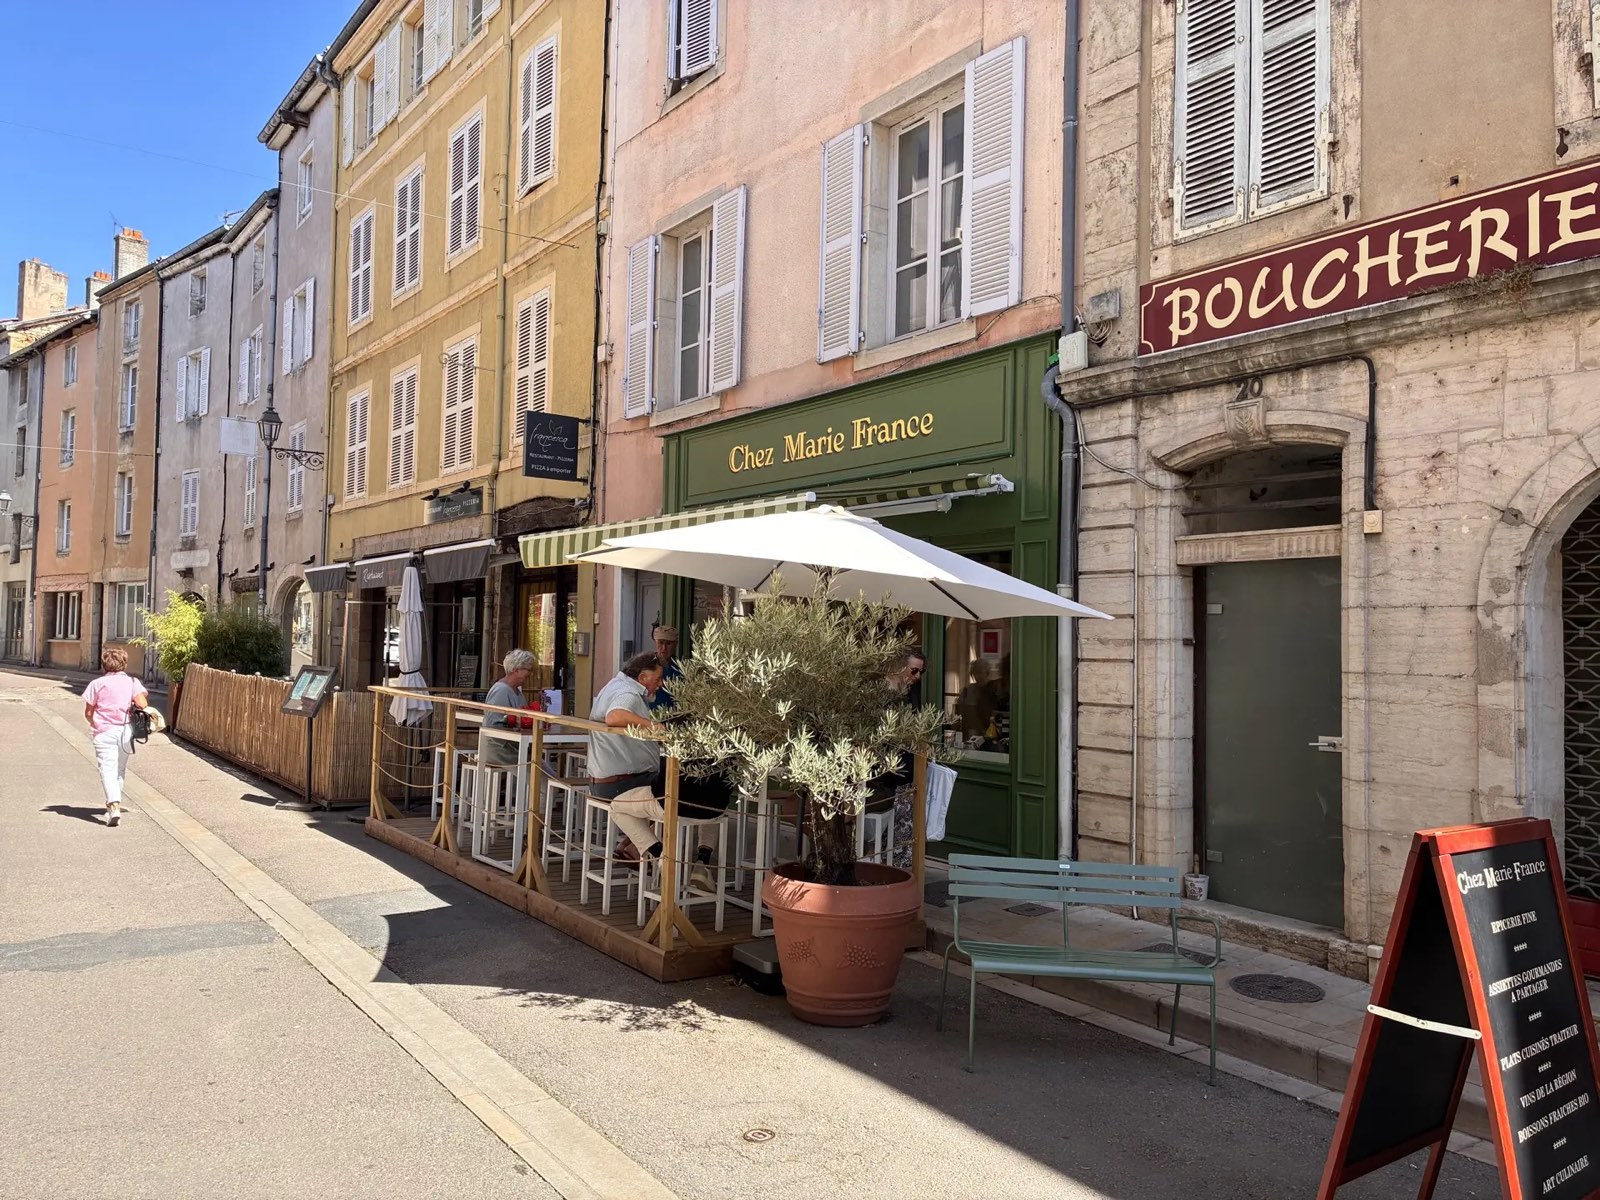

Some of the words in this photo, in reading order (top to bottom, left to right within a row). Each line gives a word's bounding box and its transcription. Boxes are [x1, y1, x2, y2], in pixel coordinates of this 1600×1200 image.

[1164, 182, 1600, 346] BOUCHERIE
[1235, 377, 1263, 400] 20
[728, 443, 774, 473] Chez
[783, 427, 844, 463] Marie
[851, 412, 934, 449] France
[1457, 871, 1485, 894] Chez
[1484, 865, 1513, 888] Marie
[1514, 860, 1546, 881] France
[1490, 914, 1522, 934] EPICERIE
[1522, 910, 1538, 925] FINE
[1488, 974, 1523, 997] ASSIETTES
[1522, 958, 1563, 983] GOURMANDES
[1511, 991, 1517, 1003] A
[1517, 979, 1549, 1001] PARTAGER
[1500, 1051, 1522, 1071] PLATS
[1549, 1023, 1579, 1048] TRAITEUR
[1519, 1088, 1537, 1109] VINS
[1535, 1085, 1546, 1101] DE
[1544, 1079, 1556, 1096] LA
[1553, 1069, 1577, 1091] RÉGION
[1517, 1116, 1550, 1144] BOISSONS
[1549, 1100, 1579, 1127] FRAICHES
[1577, 1092, 1590, 1108] BIO
[1542, 1175, 1558, 1195] ART
[1556, 1154, 1590, 1185] CULINAIRE
